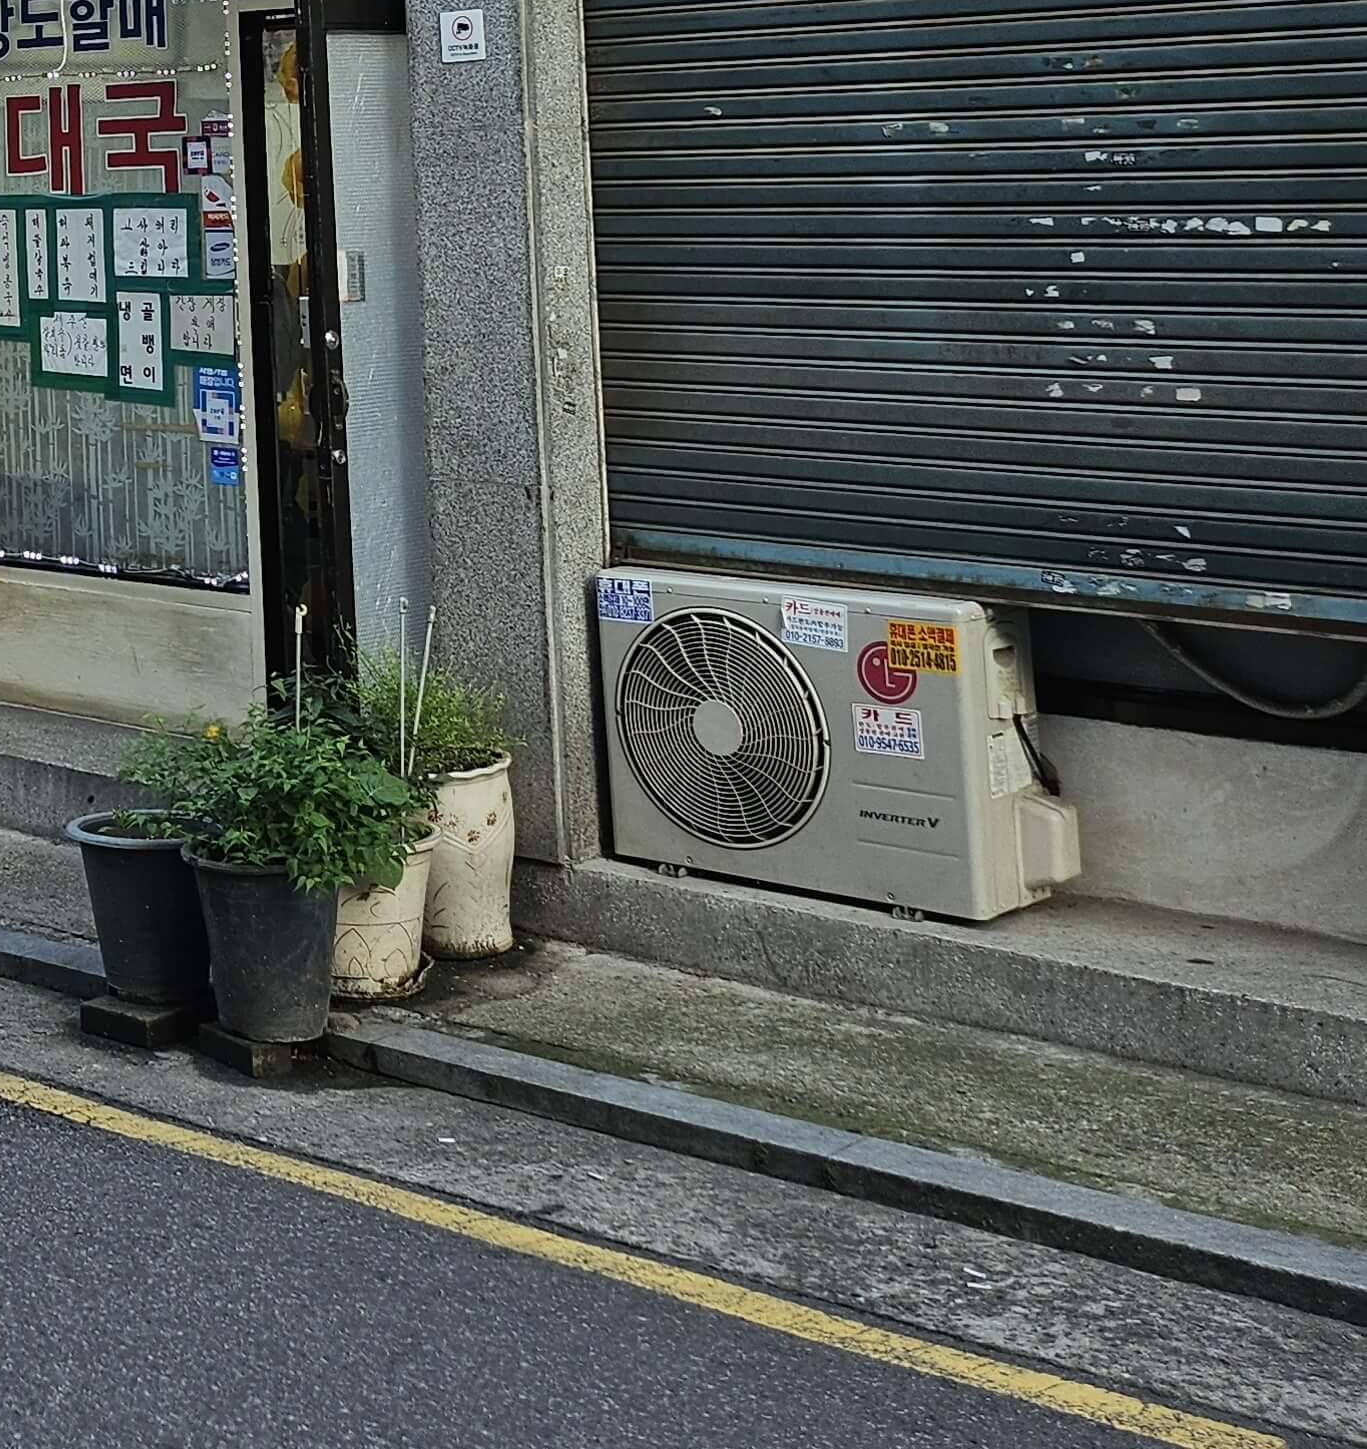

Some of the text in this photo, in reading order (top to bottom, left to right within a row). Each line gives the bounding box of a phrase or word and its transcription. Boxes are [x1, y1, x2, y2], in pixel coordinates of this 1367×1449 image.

[141, 302, 155, 383] 골뱅이
[859, 809, 940, 829] INVERTER V
